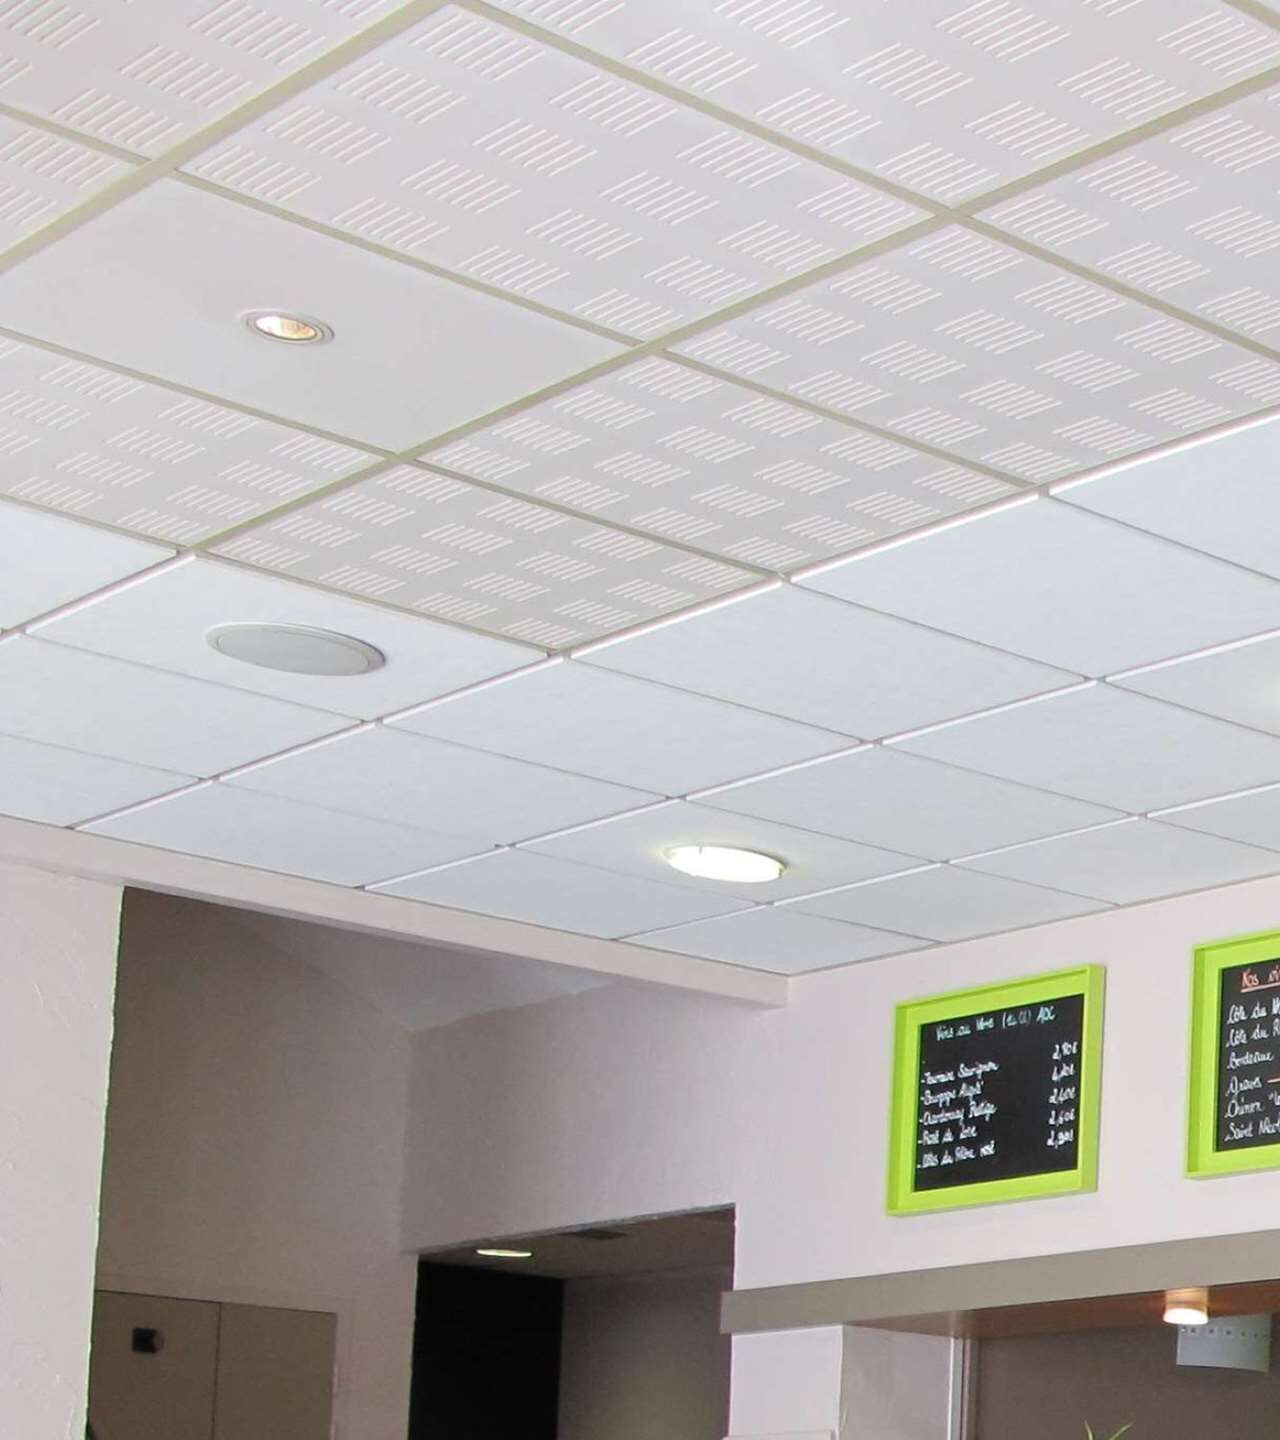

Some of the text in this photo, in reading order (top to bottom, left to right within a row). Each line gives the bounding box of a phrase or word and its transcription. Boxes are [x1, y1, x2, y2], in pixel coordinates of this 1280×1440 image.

[1241, 969, 1260, 988] Nos
[1250, 1002, 1267, 1019] du
[1251, 1023, 1269, 1041] du
